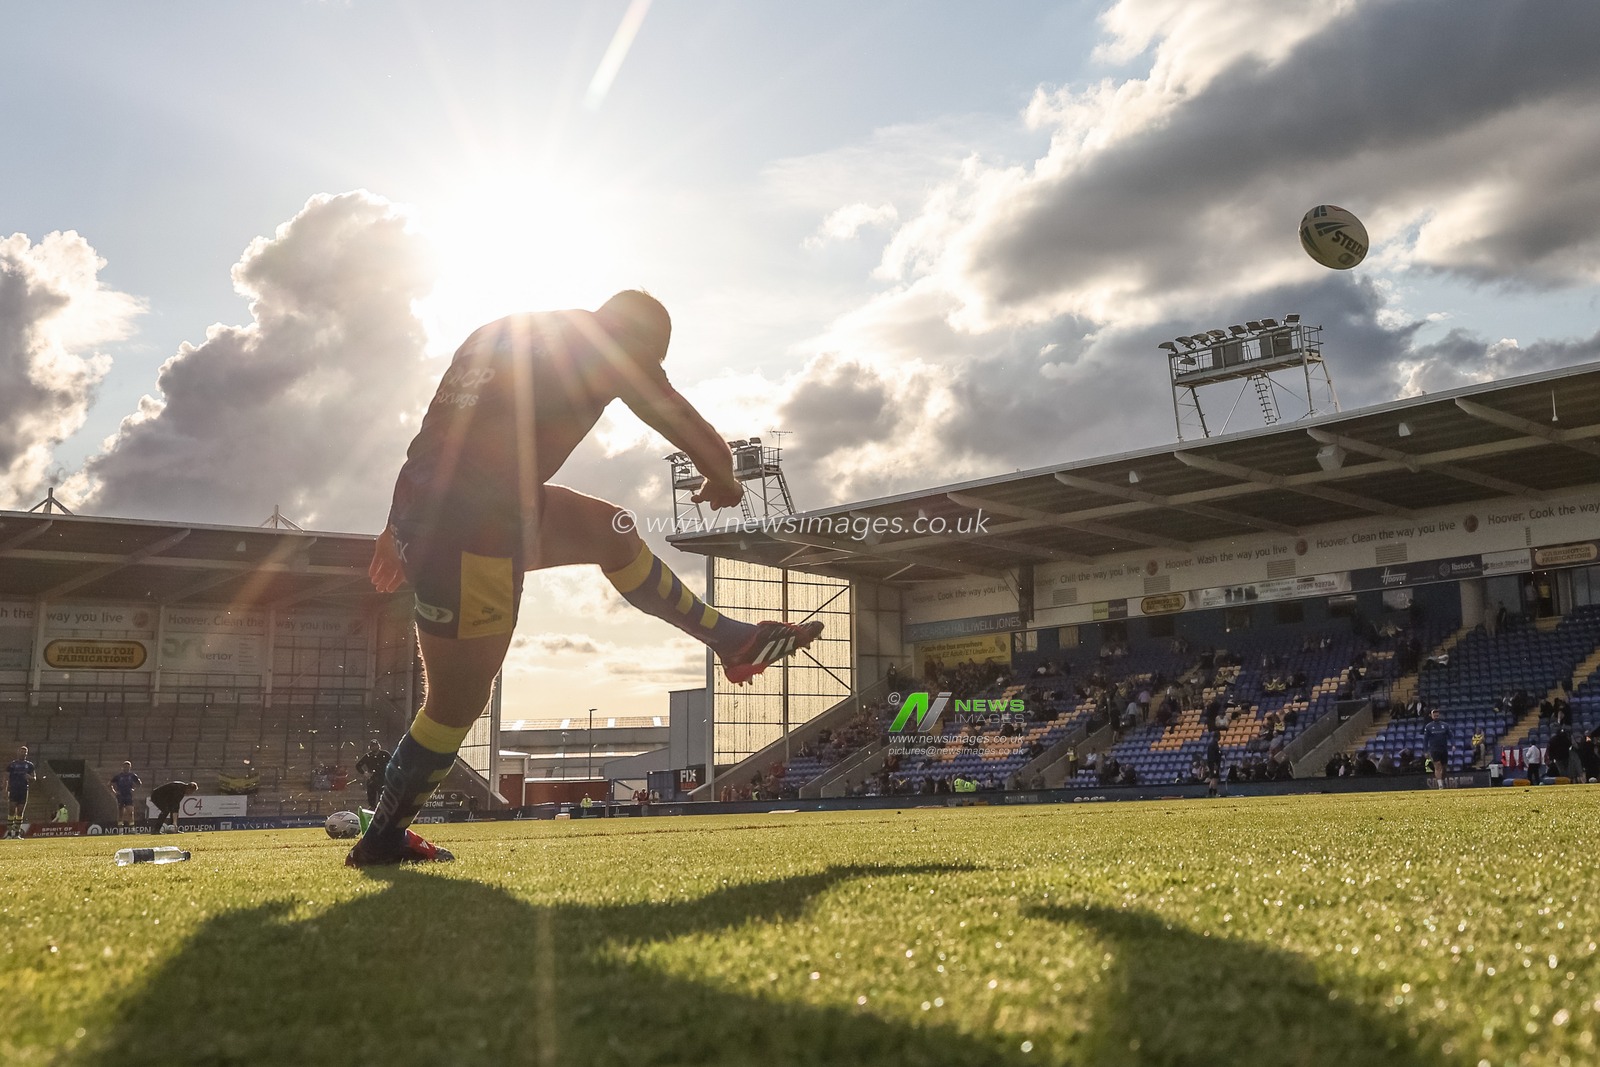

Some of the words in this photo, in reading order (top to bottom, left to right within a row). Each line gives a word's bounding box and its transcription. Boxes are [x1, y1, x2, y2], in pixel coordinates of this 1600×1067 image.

[1488, 512, 1525, 525] Hoover.
[1529, 507, 1555, 520] Cook
[1558, 504, 1577, 516] the
[1579, 502, 1600, 514] way
[1316, 537, 1349, 549] Hoover.
[1352, 532, 1377, 544] Clean
[1379, 529, 1394, 540] the
[1396, 526, 1415, 538] way
[1418, 525, 1435, 537] you
[1438, 521, 1456, 532] live
[1165, 558, 1194, 569] Hoover.
[1197, 553, 1217, 565] Wash
[1220, 552, 1233, 562] the
[1236, 550, 1252, 561] way
[1255, 548, 1271, 559] you
[1272, 545, 1288, 555] live
[1060, 574, 1076, 584] Chill
[1078, 572, 1090, 581] the
[1093, 570, 1107, 581] way
[1110, 568, 1123, 579] you
[1127, 565, 1140, 575] live
[938, 592, 953, 601] Cook
[955, 590, 966, 598] the
[968, 589, 981, 598] way
[983, 587, 996, 596] you
[997, 584, 1009, 593] live
[13, 608, 34, 619] the
[46, 612, 70, 624] way
[75, 612, 97, 624] you
[102, 612, 123, 623] live
[168, 614, 210, 626] Hoover.
[213, 615, 243, 627] Clean
[247, 617, 265, 627] the
[276, 620, 296, 631] way
[300, 622, 319, 632] you
[322, 622, 341, 631] live
[995, 616, 1021, 630] JONES
[56, 654, 135, 663] FABRICATIONS
[58, 646, 135, 655] WARRINGTON
[681, 769, 696, 783] FIX
[182, 797, 203, 816] C4
